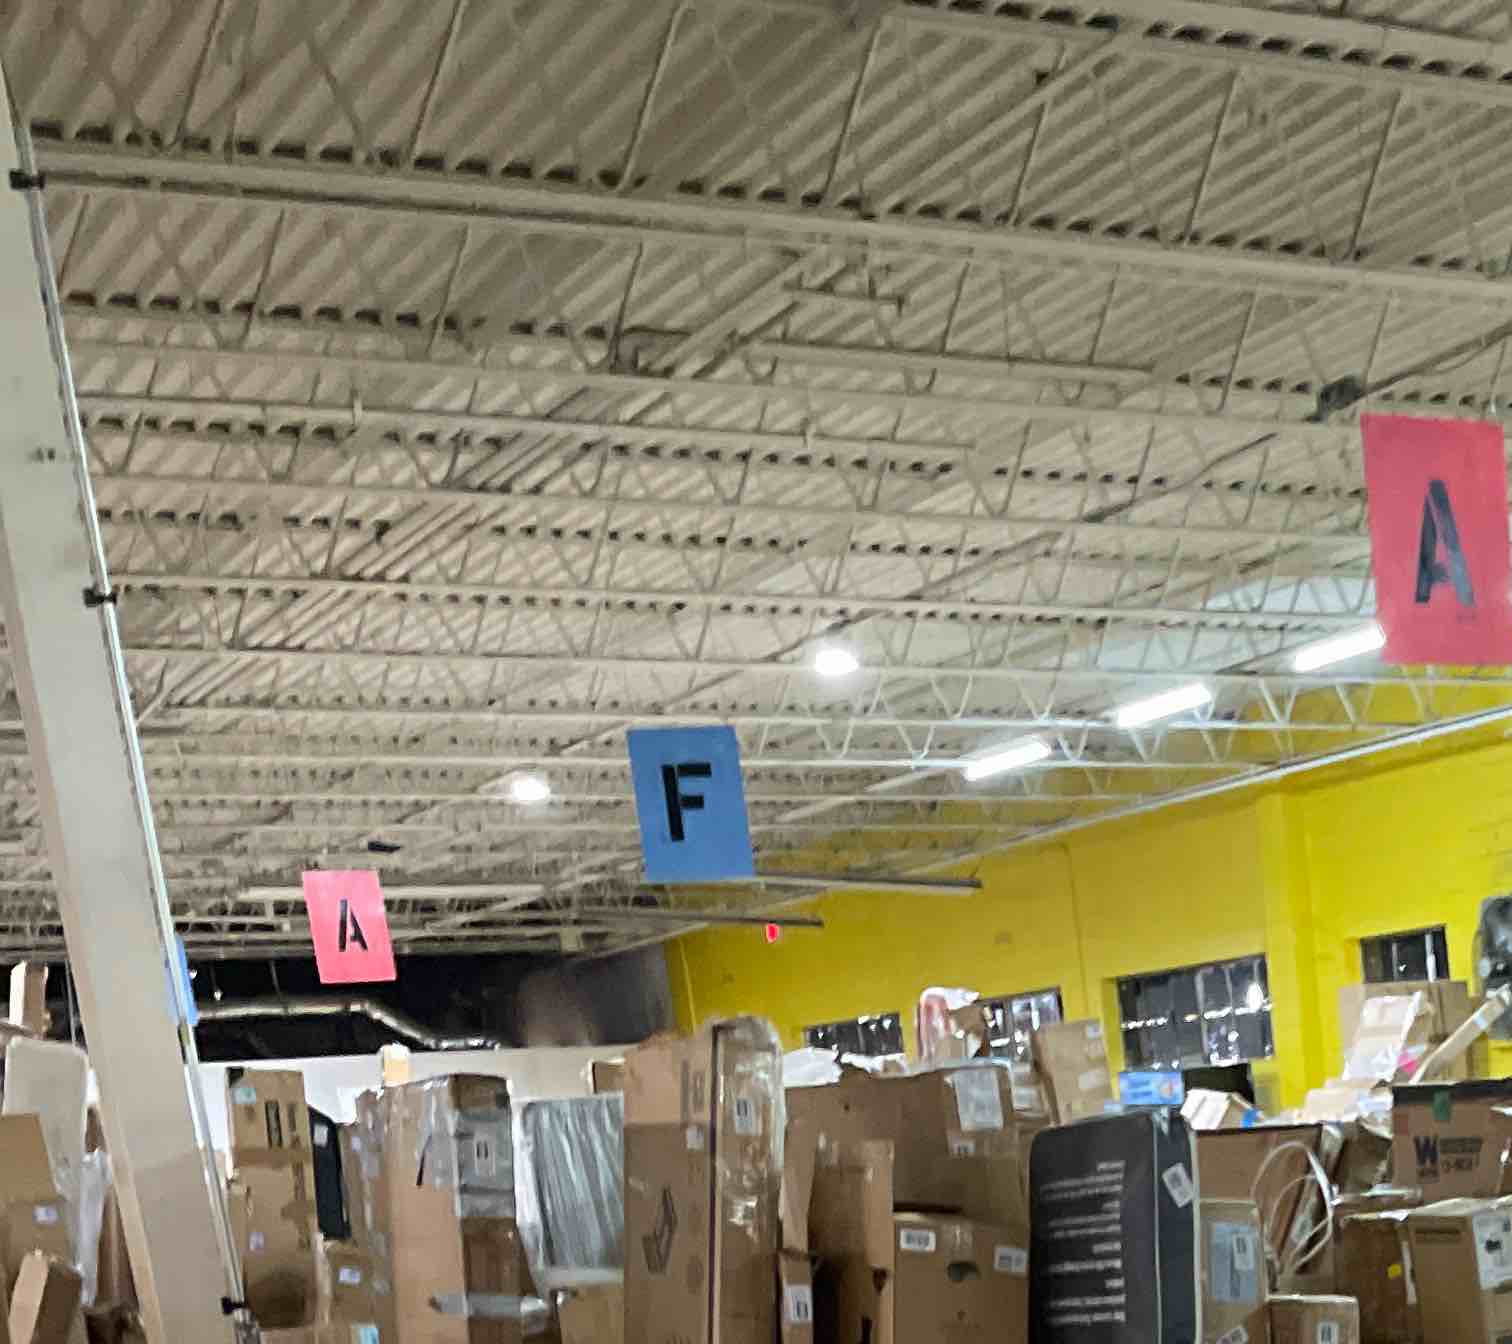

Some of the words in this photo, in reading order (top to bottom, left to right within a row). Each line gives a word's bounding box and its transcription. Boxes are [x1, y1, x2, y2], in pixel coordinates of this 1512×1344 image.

[1415, 478, 1476, 608] A
[661, 762, 712, 842] F
[338, 899, 369, 953] A
